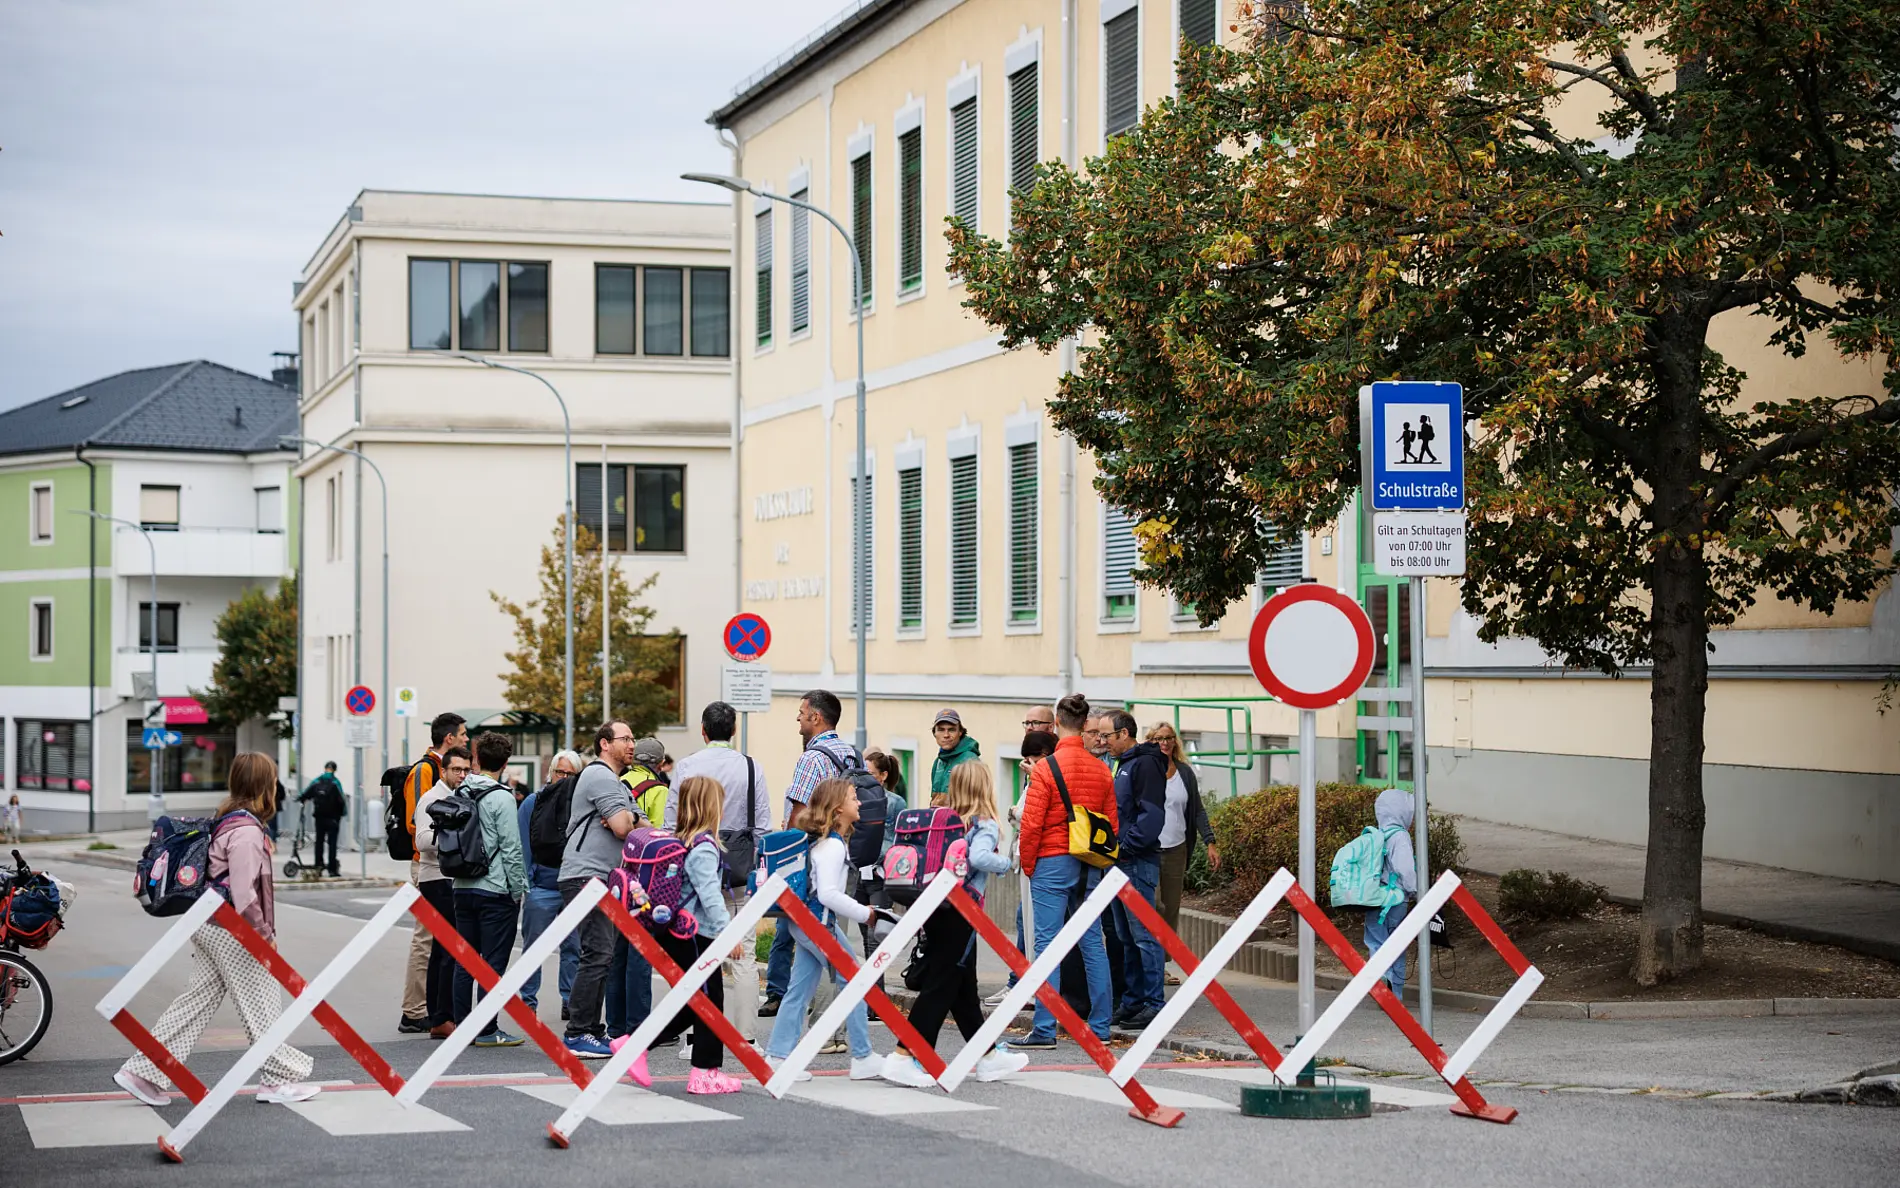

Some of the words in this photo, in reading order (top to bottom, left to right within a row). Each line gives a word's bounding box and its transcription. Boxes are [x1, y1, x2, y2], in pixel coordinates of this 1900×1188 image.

[1379, 482, 1458, 498] Schulstraße
[1377, 525, 1394, 536] Gilt
[1397, 527, 1408, 536] an
[1411, 525, 1462, 538] Schultagen
[1388, 543, 1406, 551] von
[1408, 541, 1433, 551] 07:00
[1435, 541, 1452, 551] Uhr
[1390, 556, 1404, 567] bis
[1407, 556, 1432, 567] 08:00
[1434, 556, 1451, 567] Uhr
